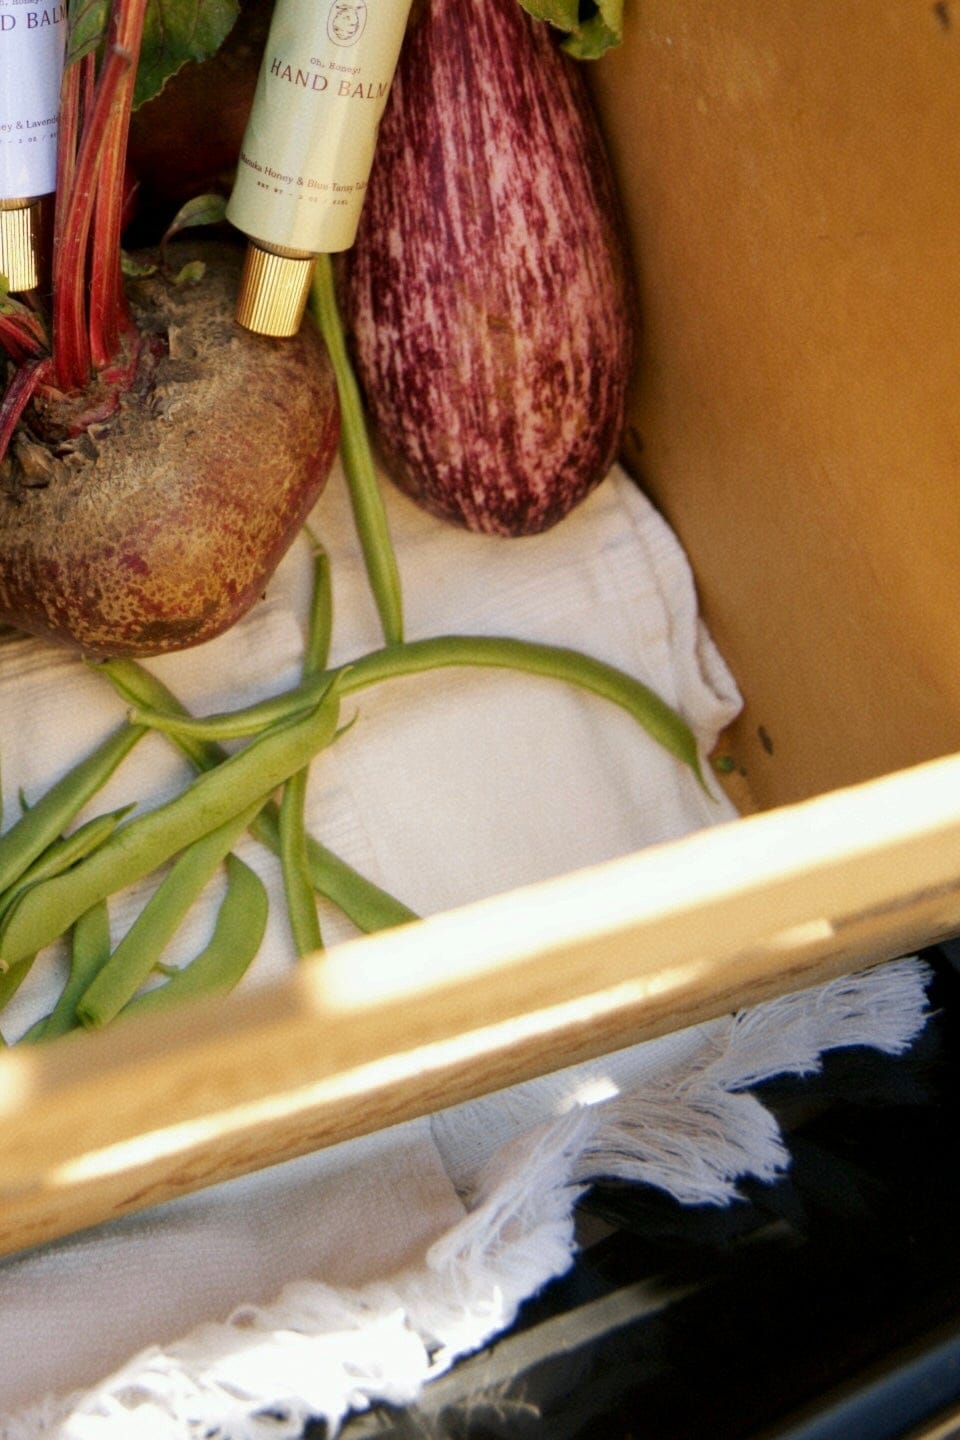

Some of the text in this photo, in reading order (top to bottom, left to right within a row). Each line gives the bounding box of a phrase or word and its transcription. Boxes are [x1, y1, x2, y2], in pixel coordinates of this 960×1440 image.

[270, 57, 329, 91] HAND
[310, 57, 361, 75] Oh, Honey!
[15, 120, 24, 129] &
[264, 166, 294, 185] Honey
[296, 177, 304, 187] &
[307, 178, 329, 191] Blue
